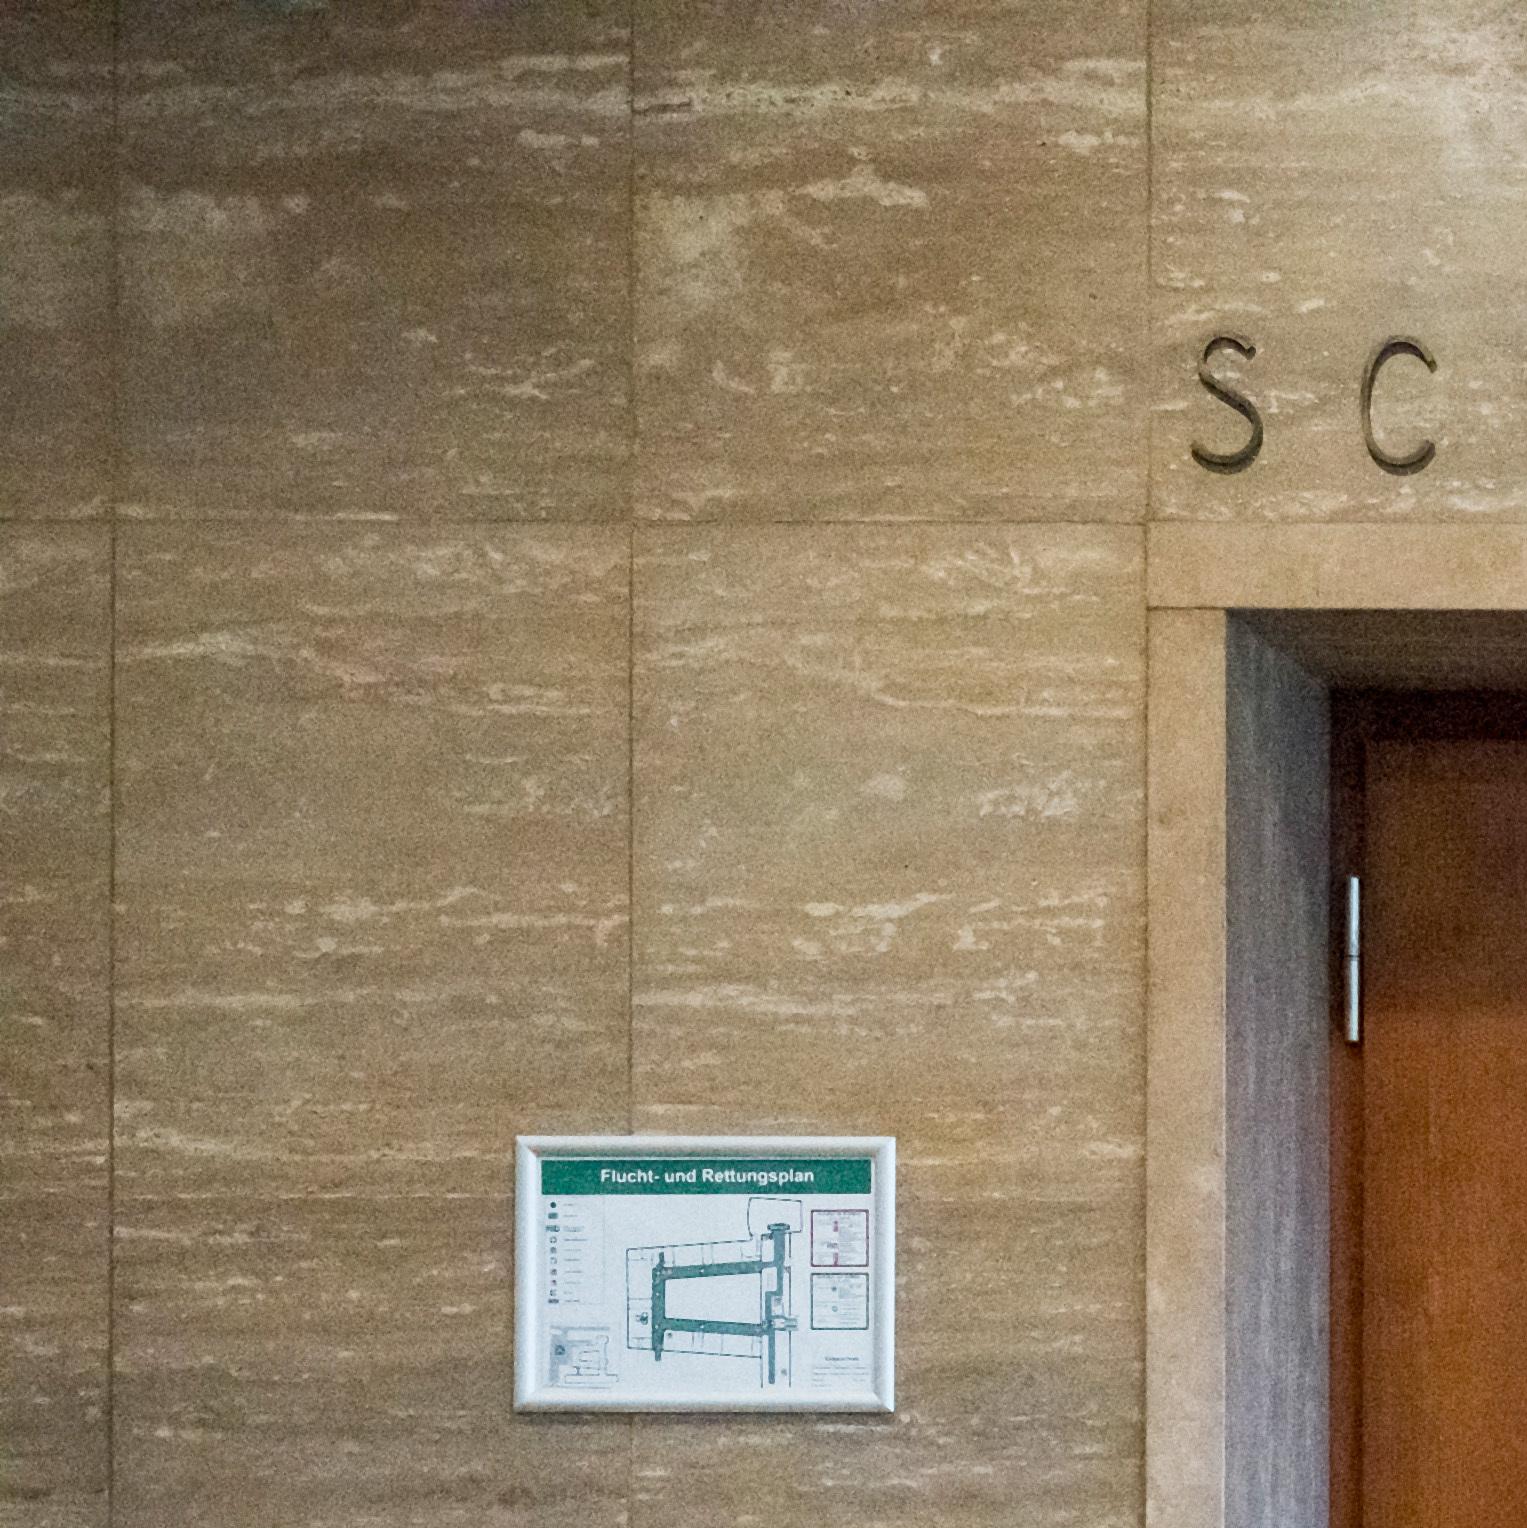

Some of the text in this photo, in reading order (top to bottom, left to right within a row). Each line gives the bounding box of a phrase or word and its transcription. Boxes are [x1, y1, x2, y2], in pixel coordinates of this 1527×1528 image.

[600, 1168, 815, 1187] Flucht- und Rettungsplan
